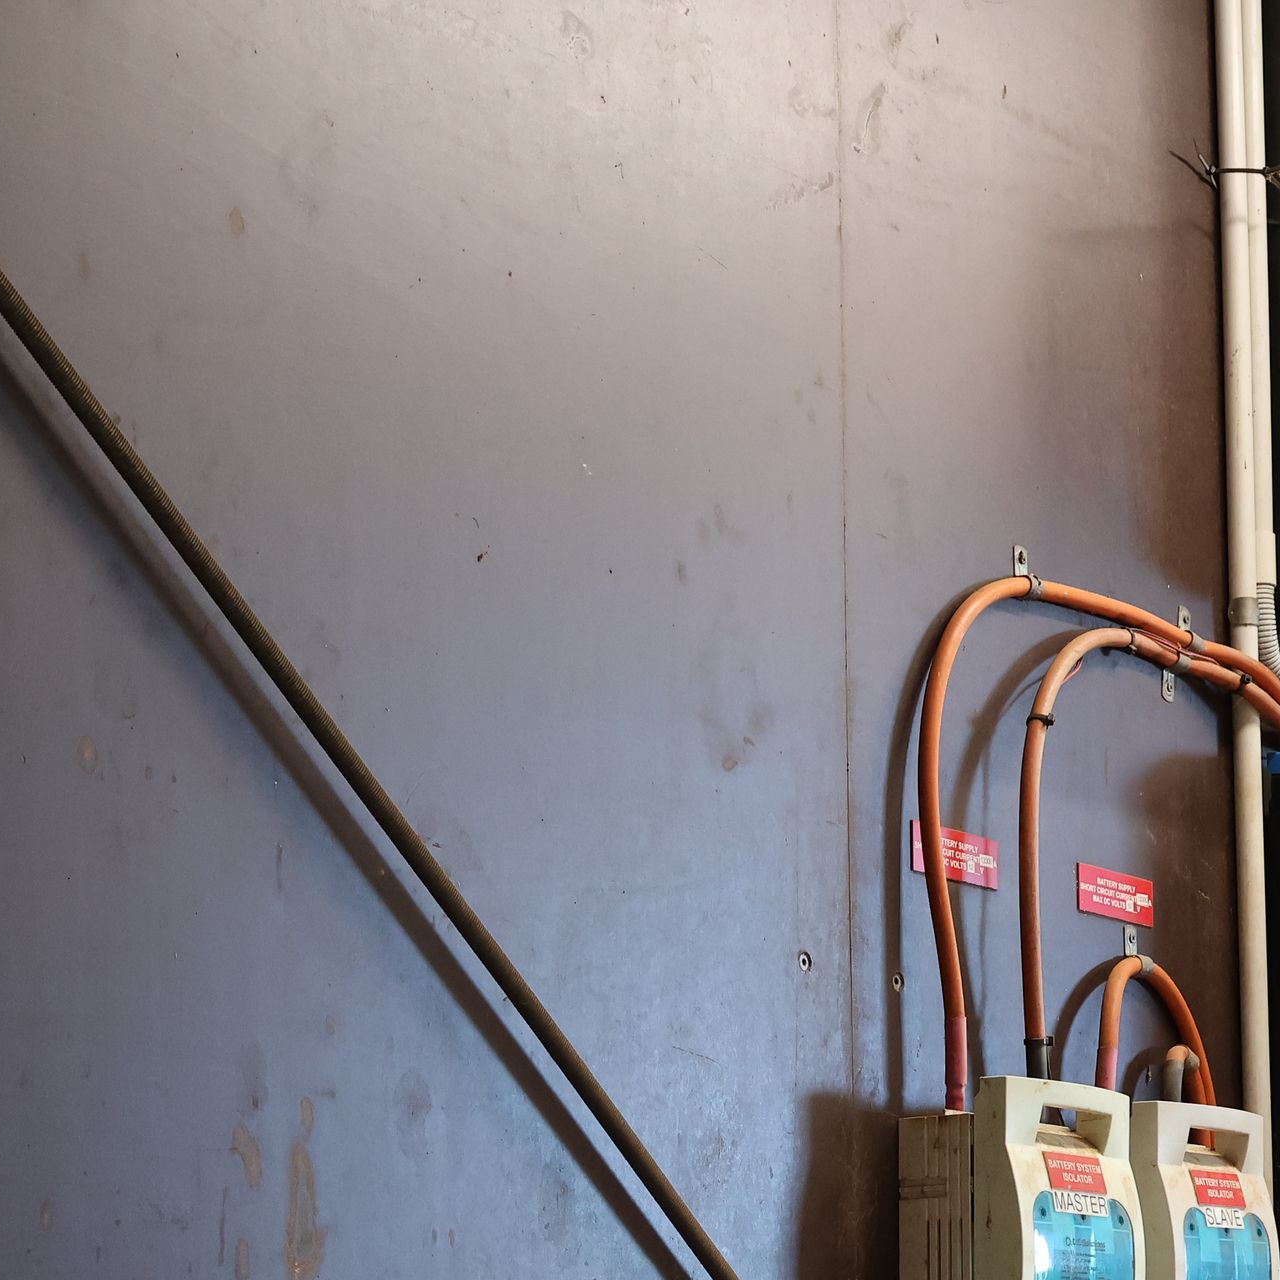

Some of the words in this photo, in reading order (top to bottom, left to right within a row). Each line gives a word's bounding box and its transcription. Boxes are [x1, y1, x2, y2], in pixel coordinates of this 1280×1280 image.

[959, 842, 979, 854] SUPPLY
[950, 859, 967, 871] VOLTS
[1080, 882, 1096, 892] SHORT
[1097, 886, 1116, 898] CIRCUIT
[1116, 892, 1137, 903] CURRENT
[1097, 877, 1118, 890] BATTERY
[1118, 882, 1136, 894] SUPPLY
[1093, 894, 1103, 903] MAX
[1104, 898, 1110, 906] DC
[1111, 899, 1126, 910] VOLTS
[1048, 1159, 1076, 1172] BATTERY
[1077, 1162, 1102, 1175] SYSTEM
[1063, 1173, 1093, 1185] ISOLATOR
[1195, 1176, 1219, 1188] BATTERY
[1220, 1178, 1240, 1190] SYSTEM
[1207, 1188, 1234, 1200] ISOLATOR
[1054, 1191, 1107, 1216] MASTER
[1205, 1207, 1243, 1227] SLAVE
